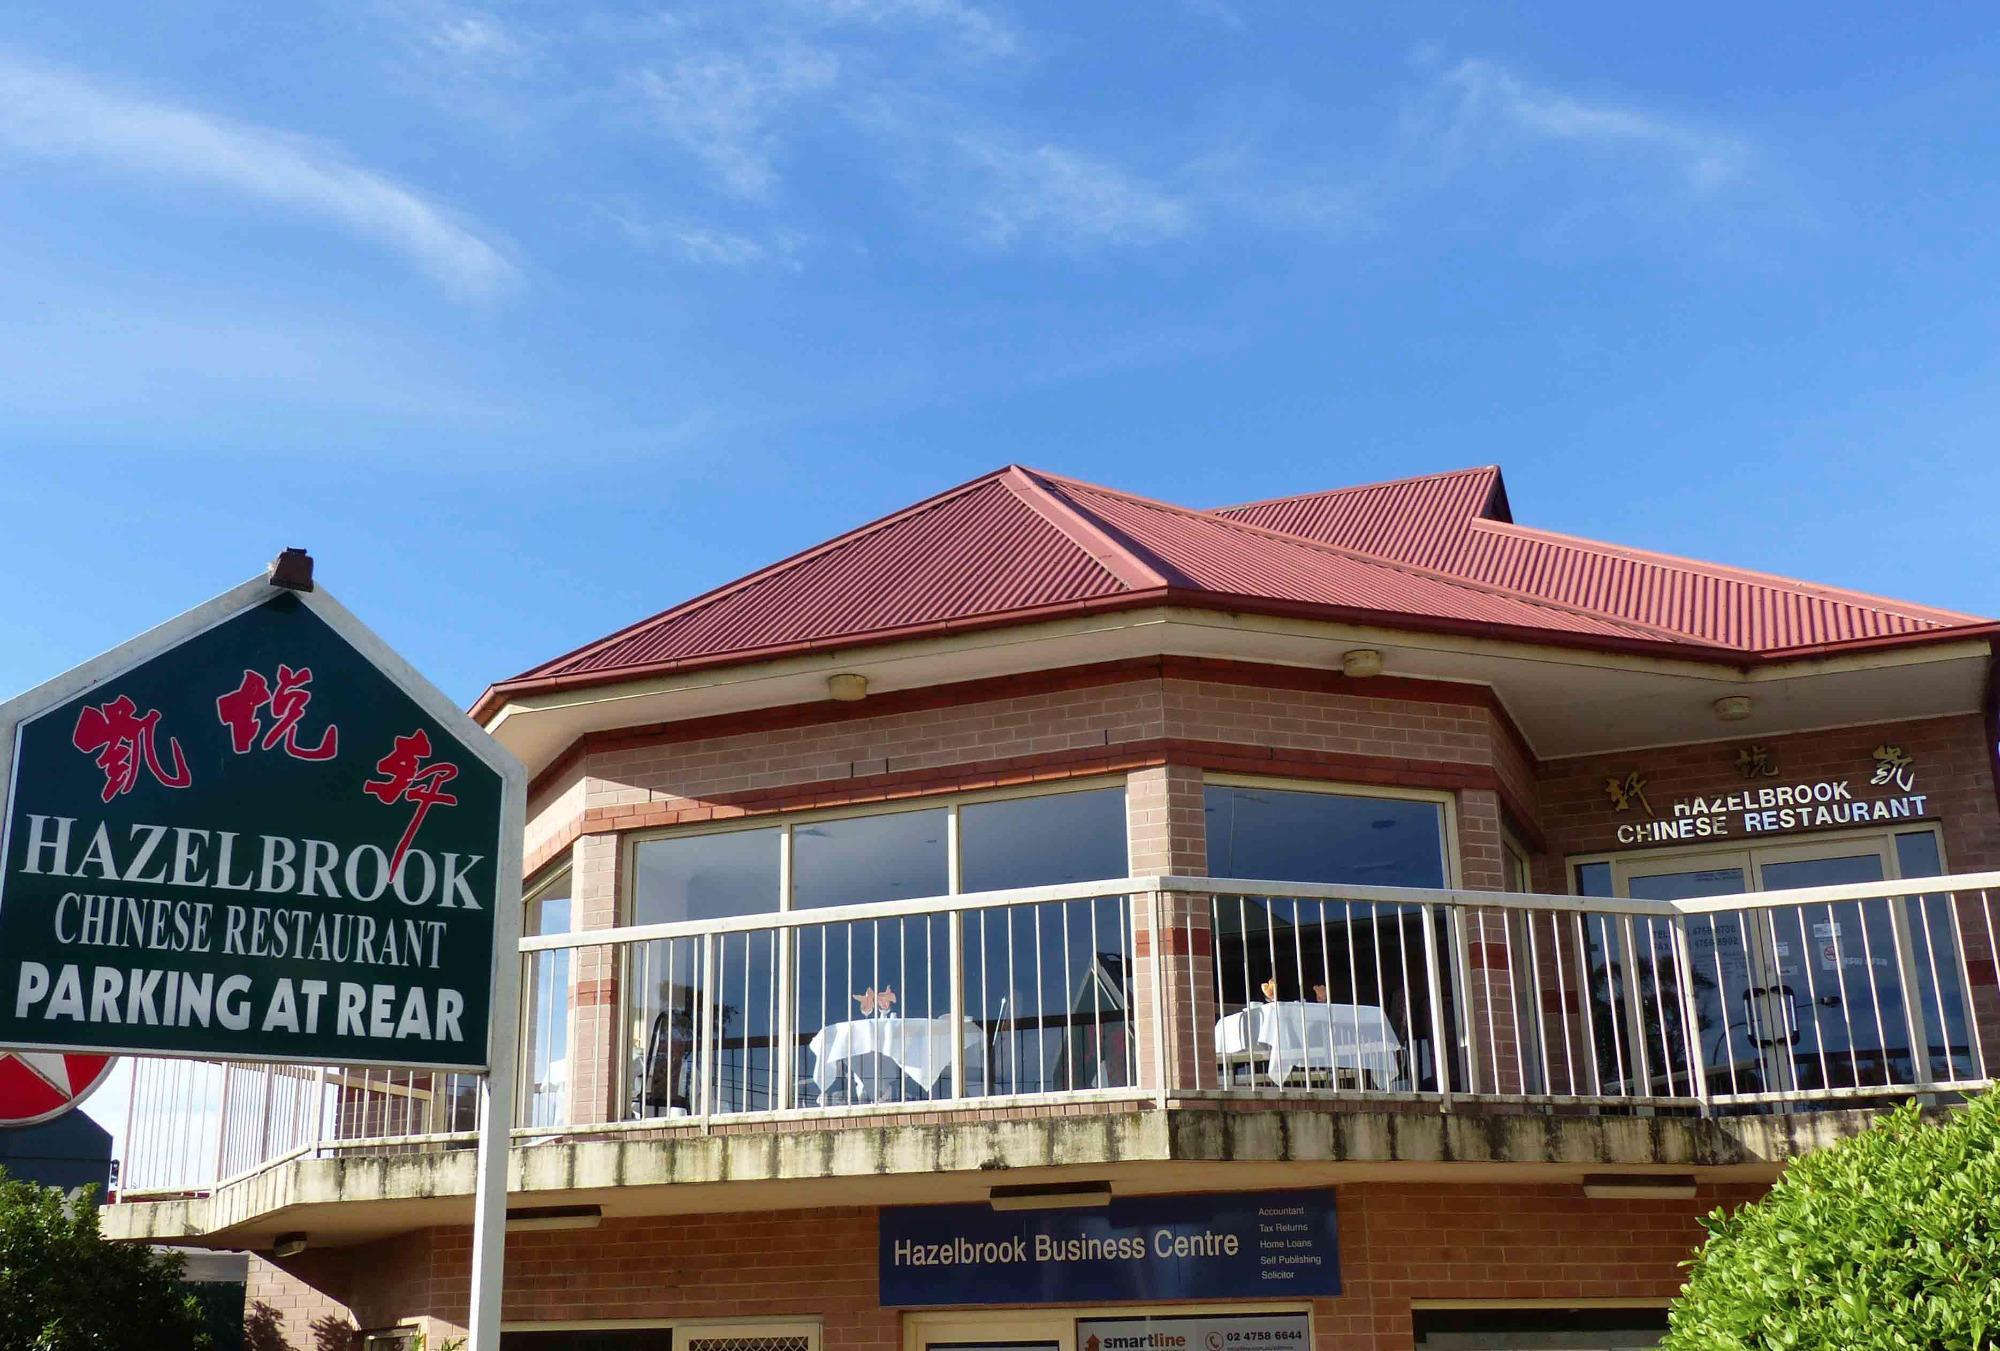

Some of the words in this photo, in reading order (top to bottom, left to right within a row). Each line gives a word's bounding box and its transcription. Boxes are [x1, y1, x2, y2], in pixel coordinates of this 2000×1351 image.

[1673, 780, 1852, 817] HAZELBROOK
[1616, 816, 1729, 844] CHINESE
[1744, 795, 1928, 833] RESTAURANT
[19, 813, 485, 911] HAZELBROOK
[54, 892, 214, 955] CHINESE
[223, 904, 448, 970] RESTAURANT
[15, 961, 254, 1031] PARKING
[261, 977, 328, 1034] AT
[336, 982, 465, 1042] REAR
[1258, 1206, 1305, 1216] Accountant
[1259, 1223, 1274, 1233] Tax
[1275, 1223, 1308, 1232] Returns
[894, 1237, 1028, 1267] Hazelbrook
[1034, 1233, 1147, 1263] Business
[1153, 1229, 1240, 1259] Centre
[1260, 1240, 1285, 1249] Home
[1286, 1239, 1312, 1248] Loans
[1260, 1255, 1277, 1265] Self
[1278, 1254, 1322, 1265] Publishing
[1261, 1270, 1295, 1280] Solicitor
[1103, 1333, 1186, 1349] smartline
[1226, 1332, 1240, 1341] 02
[1243, 1331, 1271, 1341] 4758
[1274, 1331, 1302, 1340] 6644
